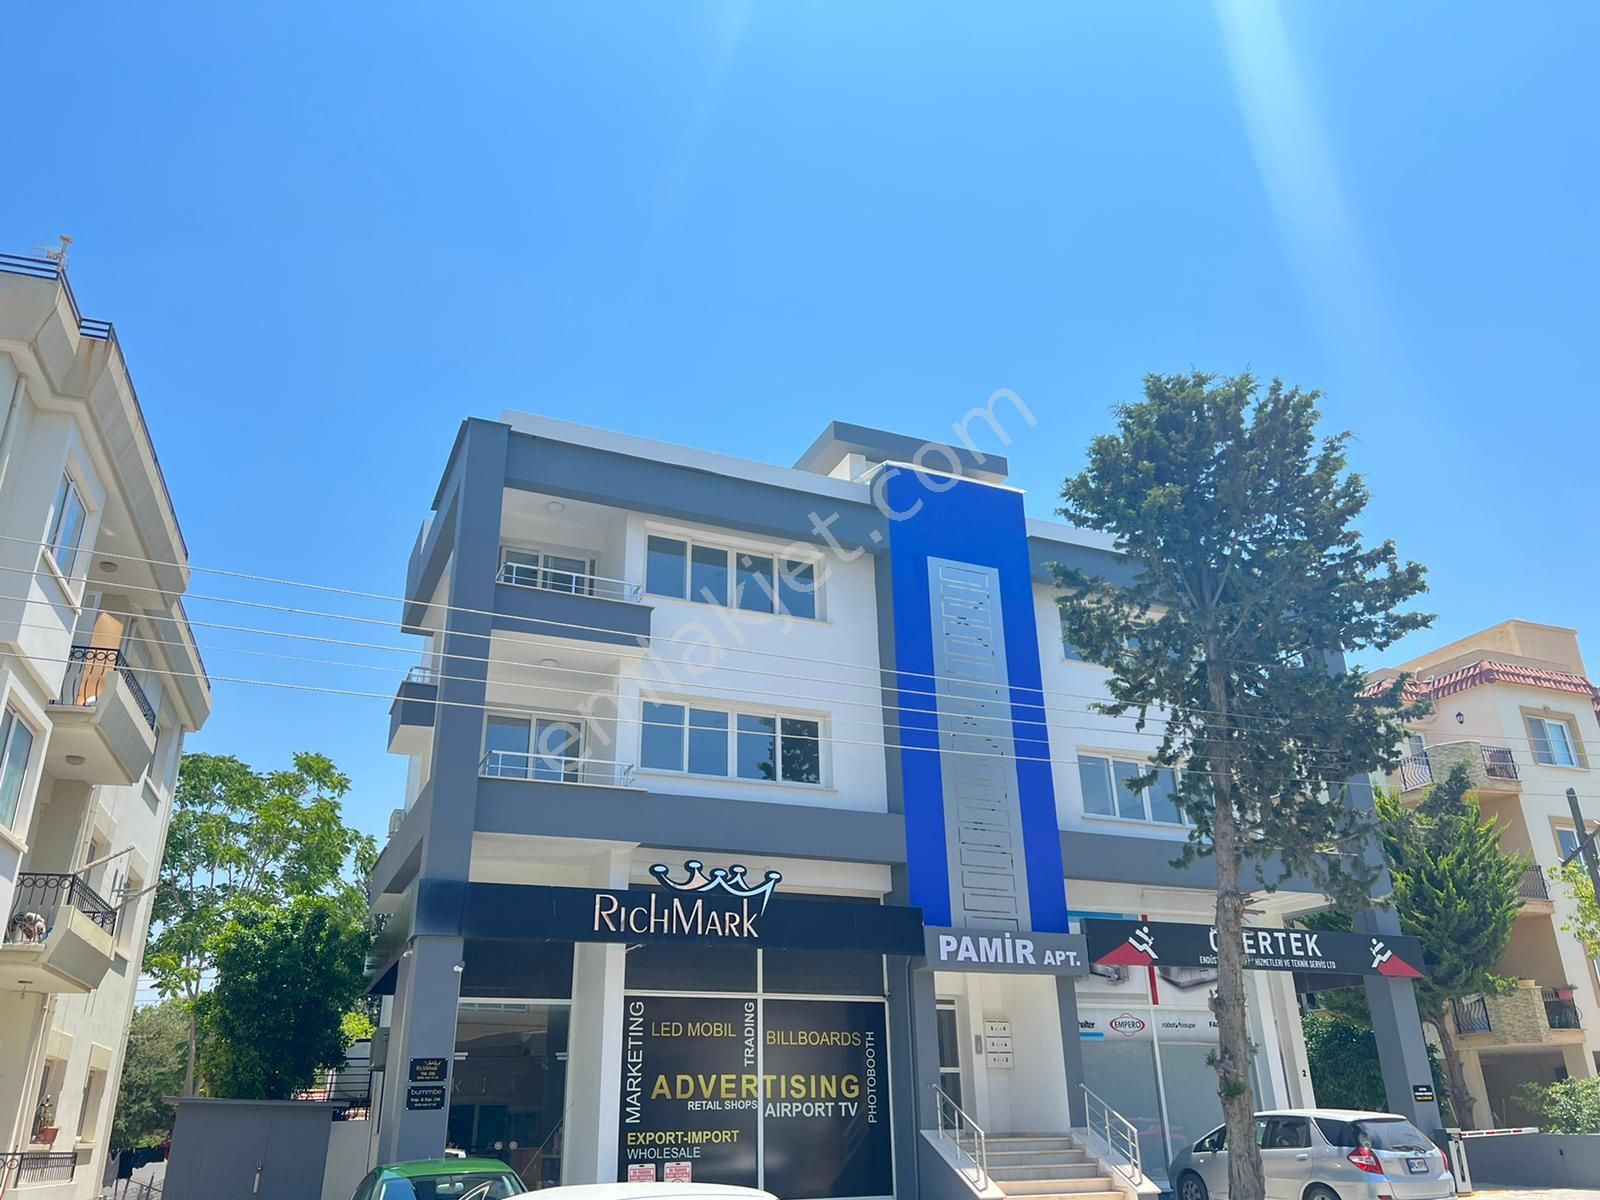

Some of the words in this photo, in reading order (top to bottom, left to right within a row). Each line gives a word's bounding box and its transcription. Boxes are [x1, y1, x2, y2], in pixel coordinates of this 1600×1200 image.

[938, 932, 1037, 965] PAMİR
[1043, 950, 1081, 966] APT.
[1209, 927, 1322, 957] ÖERTEK
[651, 1022, 683, 1037] LED
[687, 1022, 736, 1037] MOBIL
[1114, 1020, 1141, 1029] EMPERO
[744, 1001, 755, 1067] TRADING
[766, 1031, 861, 1046] BILLBOARDS
[625, 1001, 645, 1123] MARKETING
[865, 1031, 877, 1123] PHOTOBOOTH
[651, 1074, 860, 1099] ADVERTISING
[687, 1100, 722, 1110] RETAIL
[724, 1100, 758, 1110] SHOPS
[764, 1102, 834, 1118] AIRPORT
[838, 1102, 858, 1117] TV
[627, 1130, 740, 1145] EXPORT-IMPORT
[627, 1147, 701, 1160] WHOLESALE
